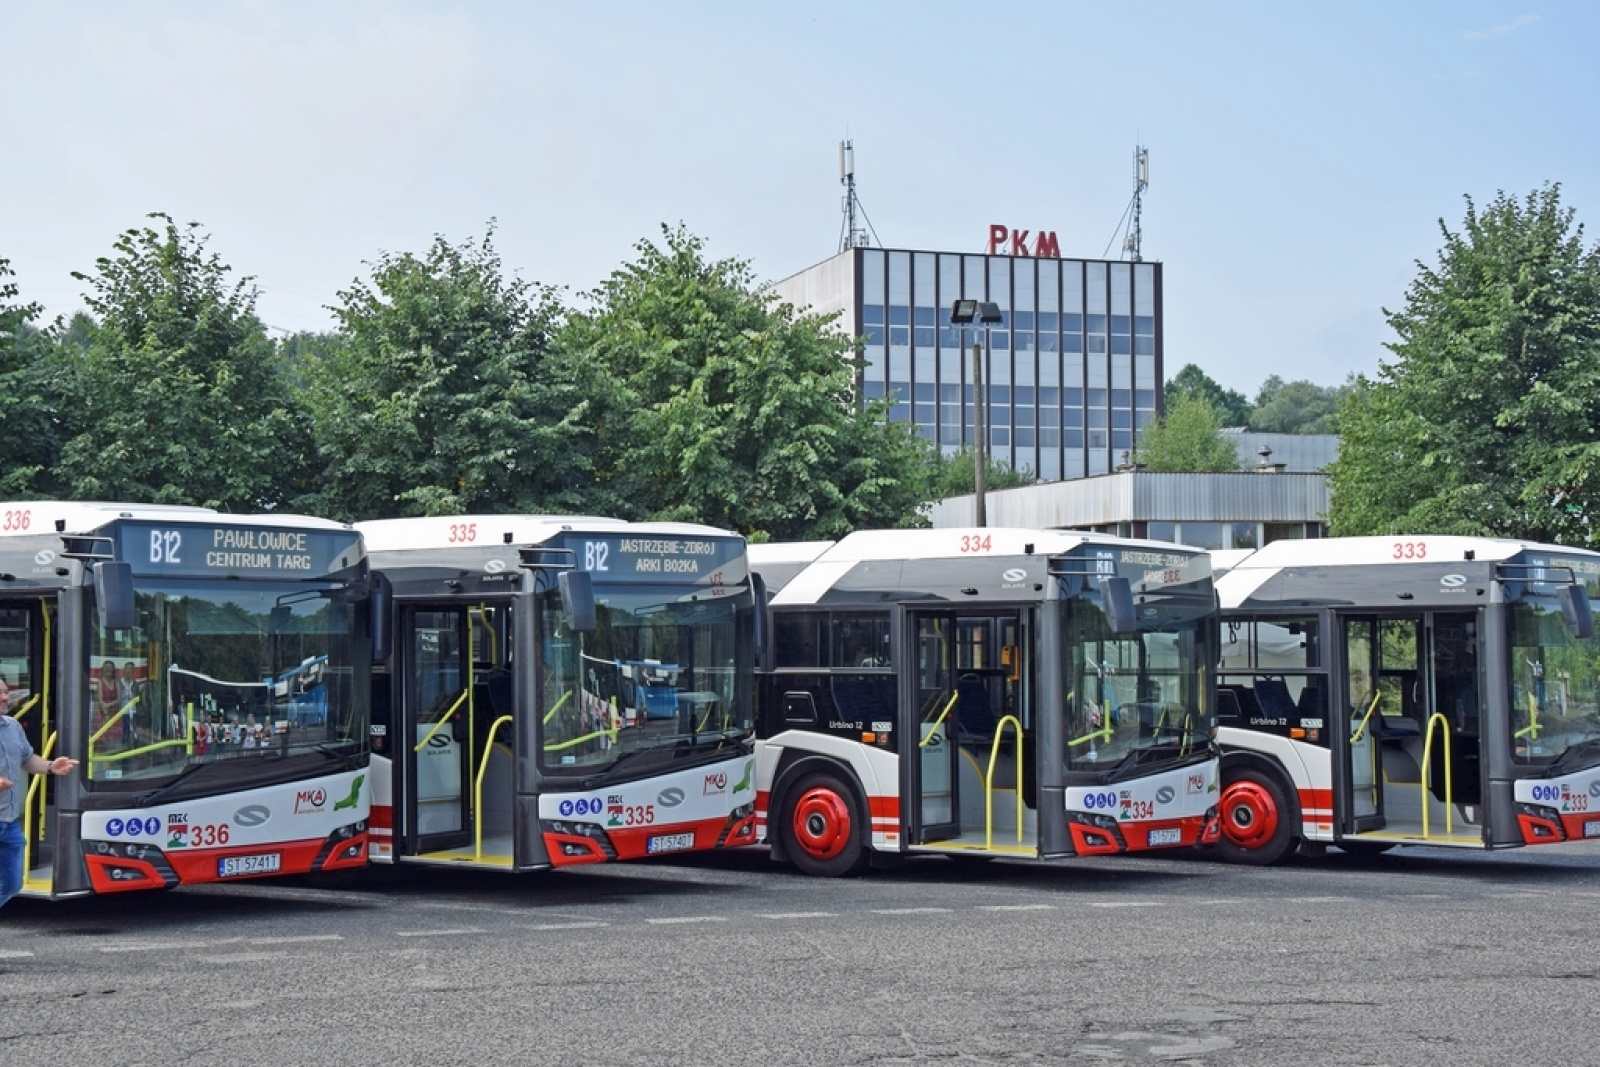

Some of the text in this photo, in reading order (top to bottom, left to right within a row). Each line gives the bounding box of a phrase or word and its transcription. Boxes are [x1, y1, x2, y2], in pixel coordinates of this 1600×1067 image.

[989, 224, 1061, 257] PKM
[2, 510, 31, 530] 336
[213, 529, 307, 551] PAWŁOWICE
[448, 523, 476, 543] 335
[150, 530, 181, 563] B12
[960, 534, 992, 552] 334
[1393, 542, 1427, 559] 333
[206, 551, 311, 570] CENTRUM TARG
[585, 541, 609, 571] B12
[635, 559, 661, 572] ARKI
[829, 720, 854, 729] Urbino
[855, 721, 863, 730] 12
[1250, 717, 1287, 726] Urbino 12
[1132, 801, 1154, 819] 334
[1571, 794, 1587, 811] 333
[625, 805, 654, 826] 335
[190, 823, 229, 847] 336
[226, 854, 278, 873] ST 5741T
